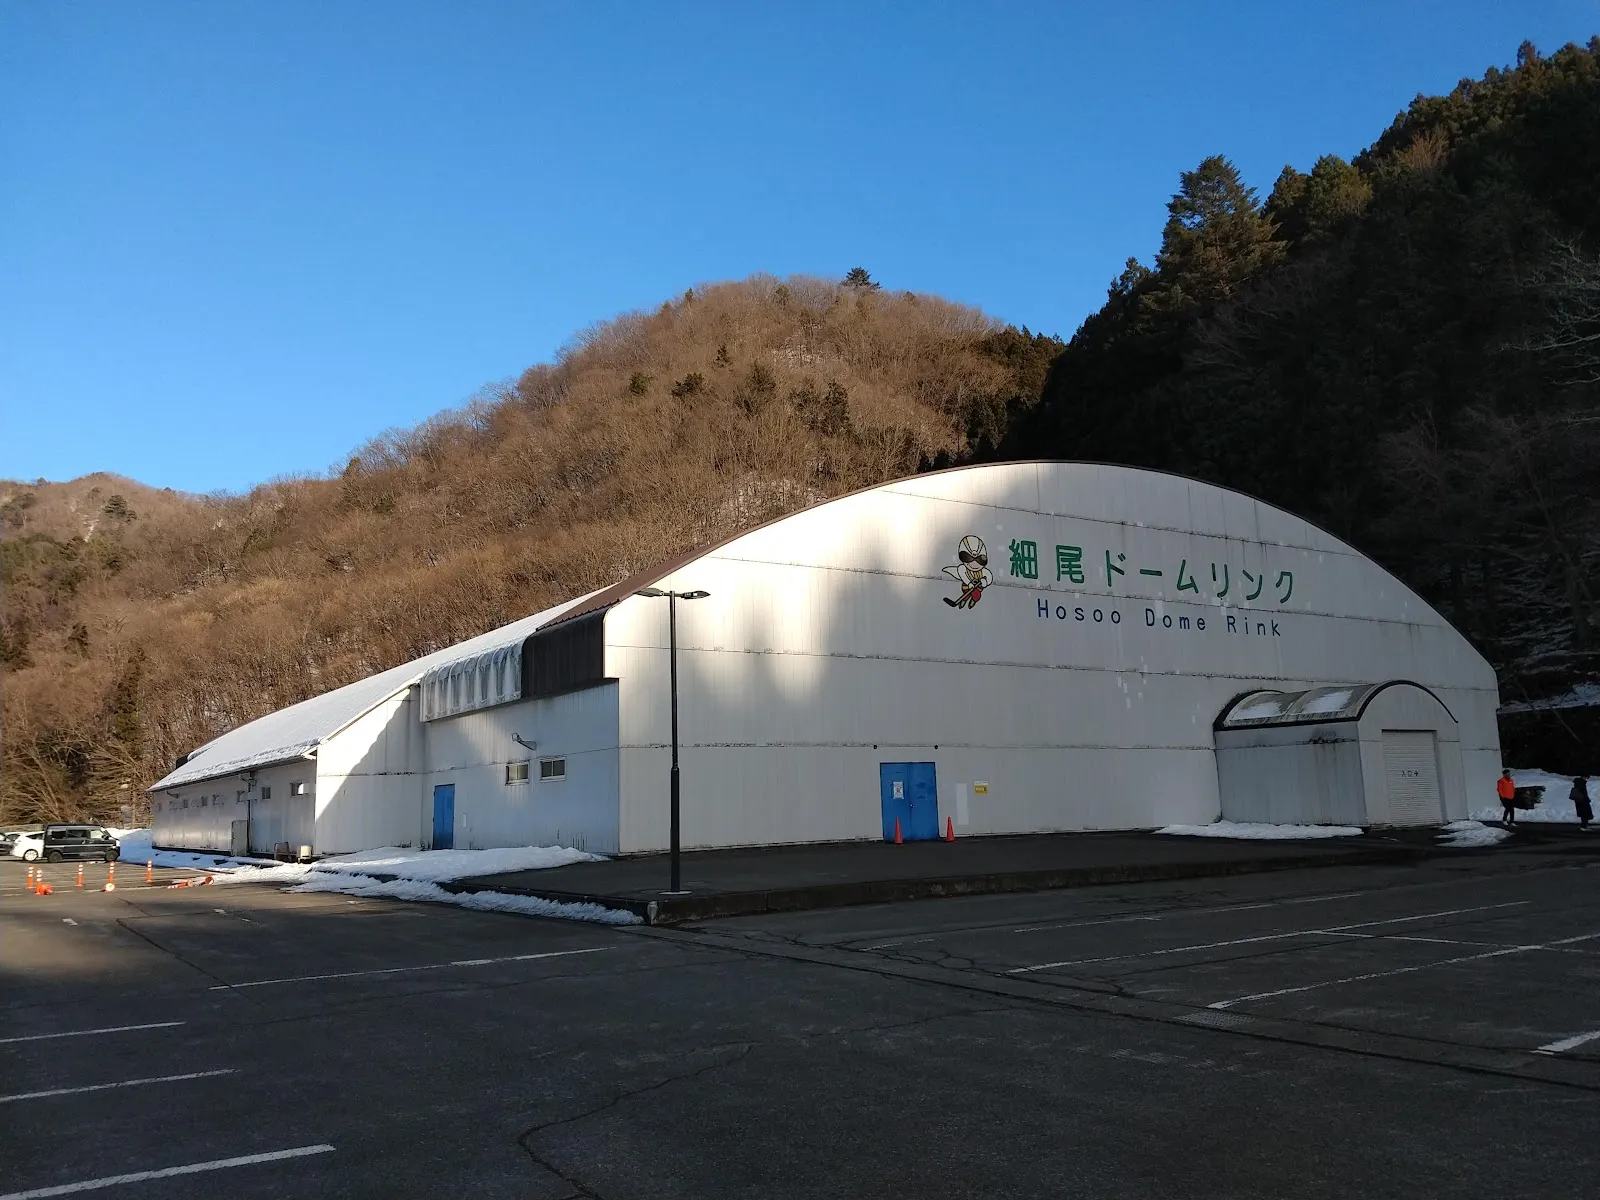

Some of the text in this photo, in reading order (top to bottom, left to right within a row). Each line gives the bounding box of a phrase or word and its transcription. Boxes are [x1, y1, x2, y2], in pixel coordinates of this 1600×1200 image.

[1009, 538, 1293, 604] 細尾ドームリンク
[1037, 598, 1281, 637] Hosoo Dome Rink
